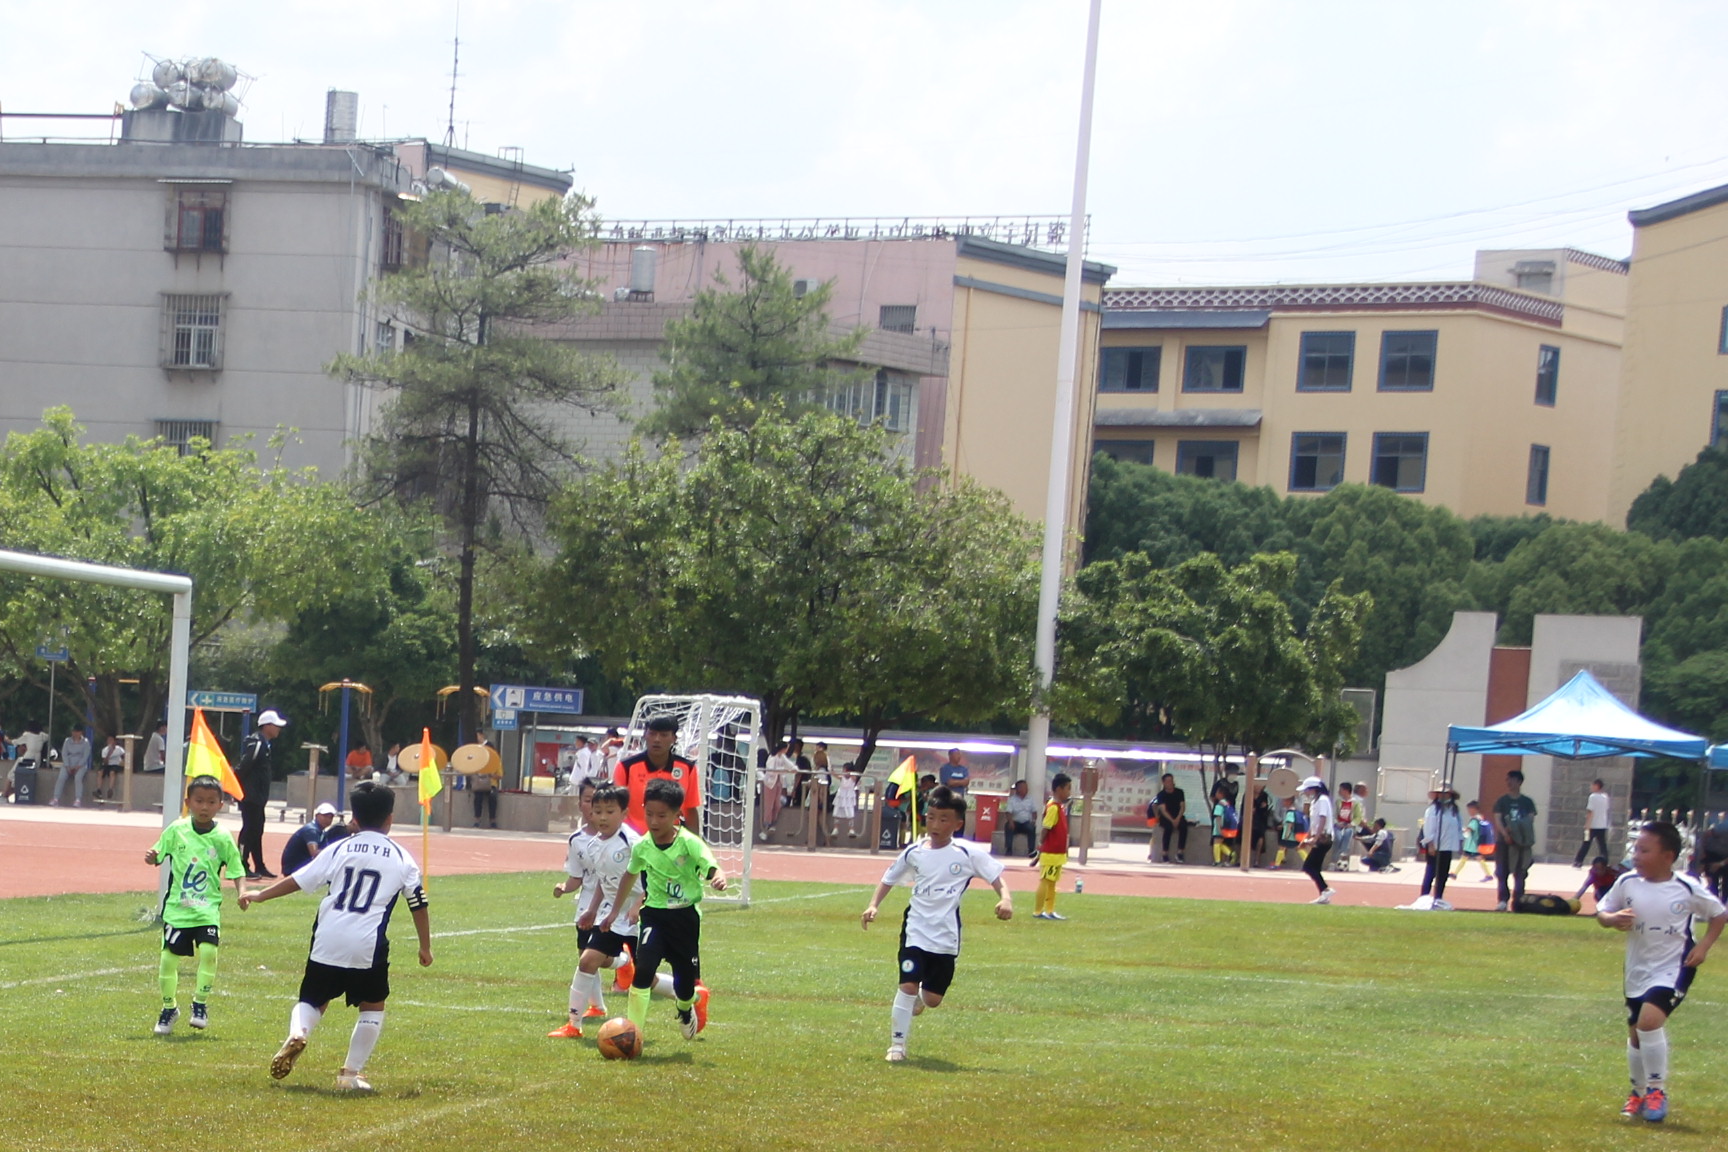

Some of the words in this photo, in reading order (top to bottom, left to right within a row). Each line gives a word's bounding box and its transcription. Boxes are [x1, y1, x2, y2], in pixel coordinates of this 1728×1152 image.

[346, 843, 369, 854] LUO
[373, 845, 380, 854] Y
[382, 847, 391, 858] H
[333, 866, 381, 914] 10
